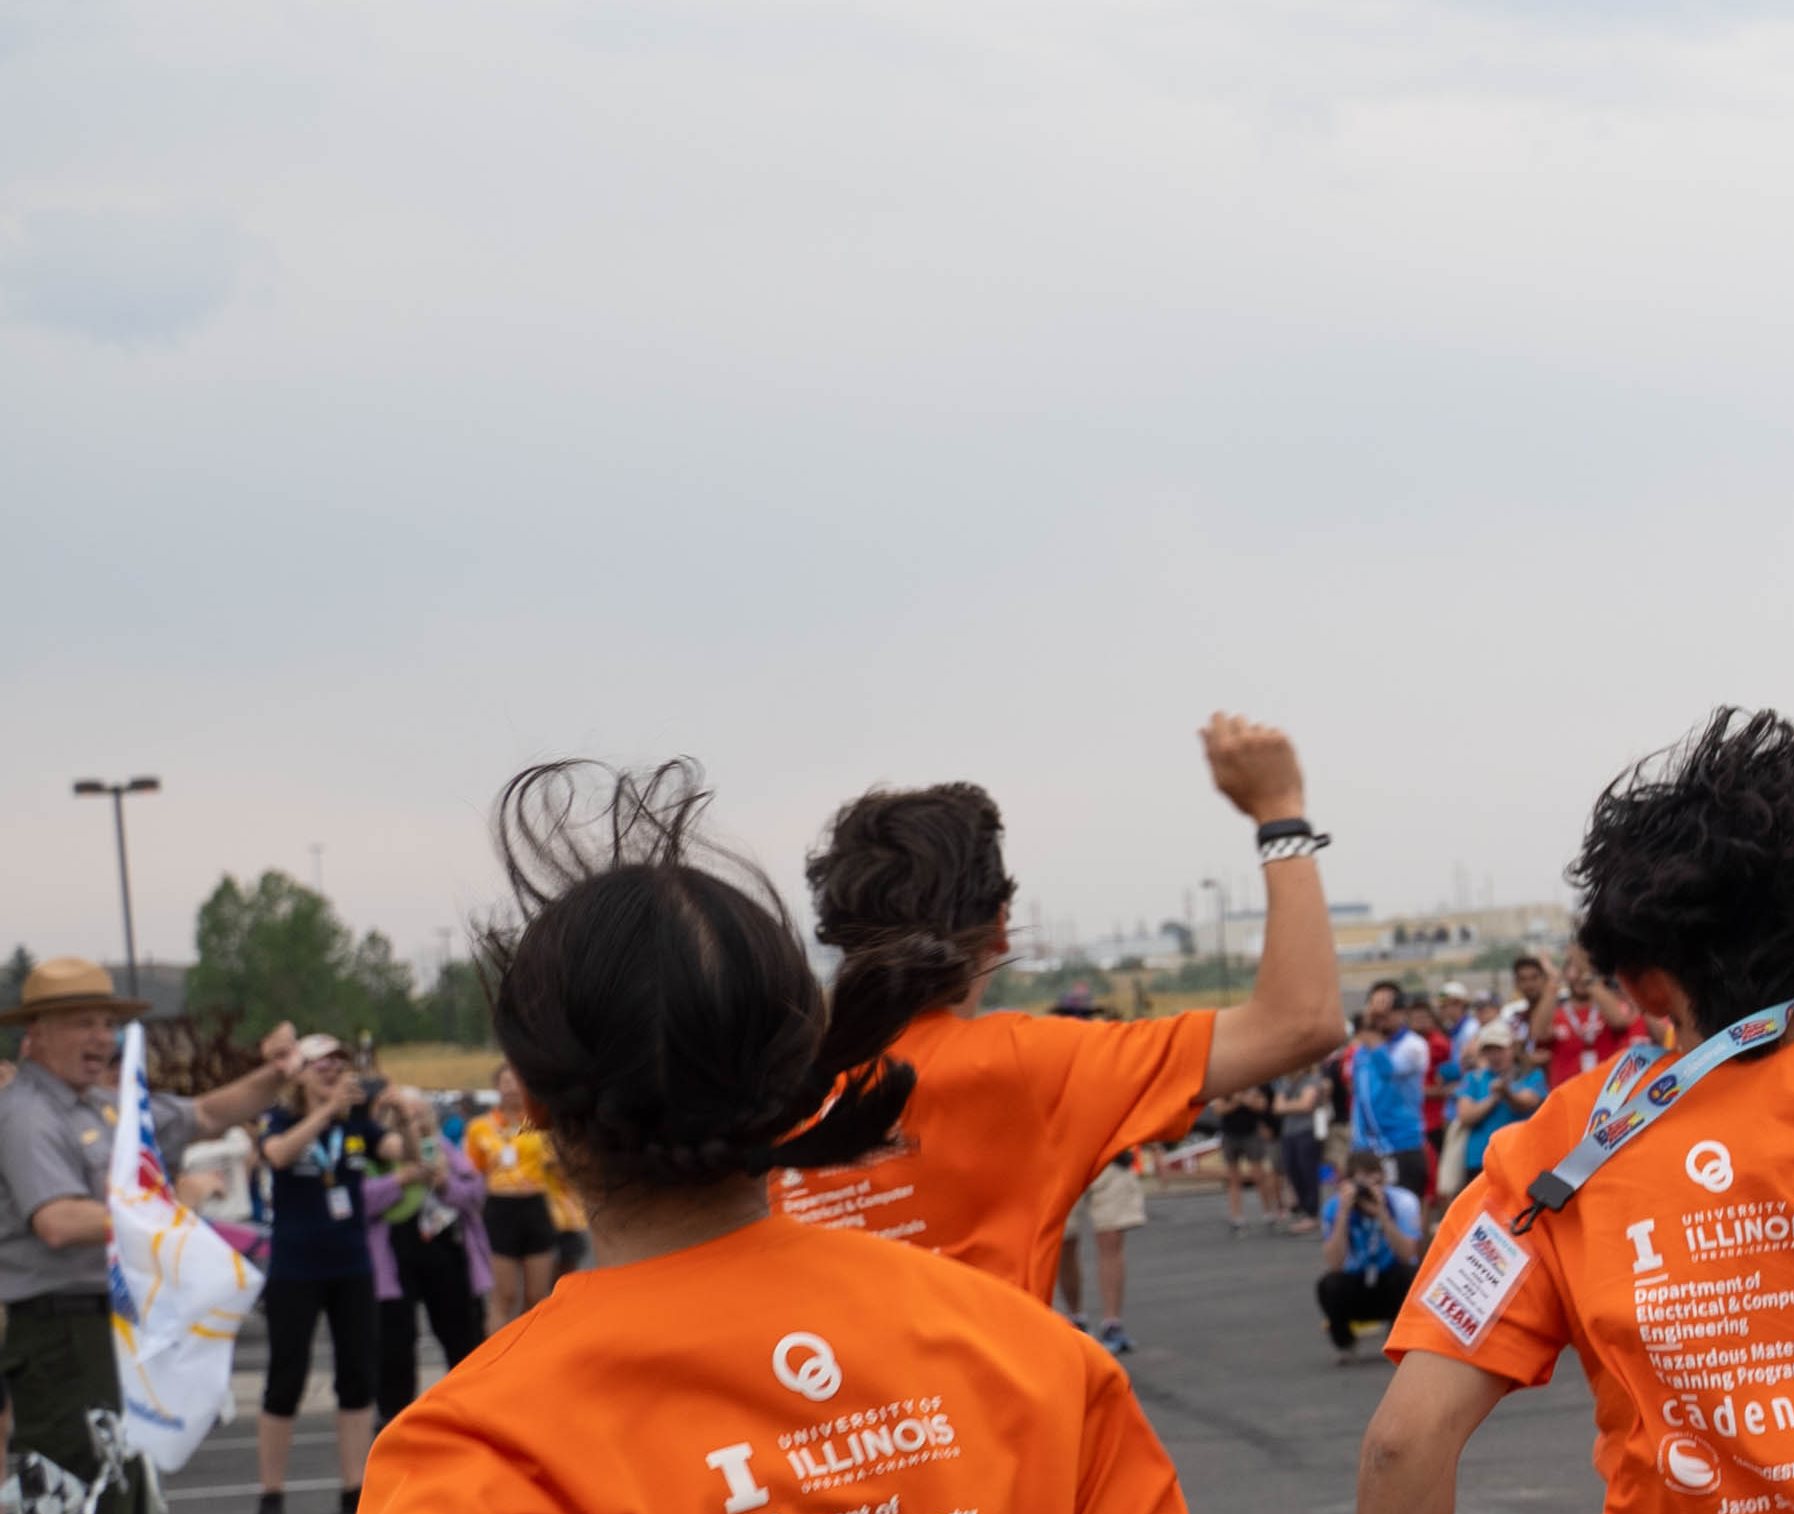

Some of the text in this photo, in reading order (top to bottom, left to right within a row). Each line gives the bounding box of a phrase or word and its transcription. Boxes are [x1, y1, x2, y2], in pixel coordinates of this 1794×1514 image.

[1681, 1200, 1787, 1226] UNIVERSITY
[1634, 1270, 1761, 1304] Department of
[1439, 1294, 1479, 1337] TEAM
[1636, 1299, 1725, 1323] Electrical
[1728, 1299, 1740, 1313] &
[1640, 1316, 1749, 1344] Engineering
[1650, 1346, 1748, 1371] Hazardous
[777, 1395, 943, 1450] UNIVERSITY OF
[787, 1413, 955, 1479] ILLINOIS
